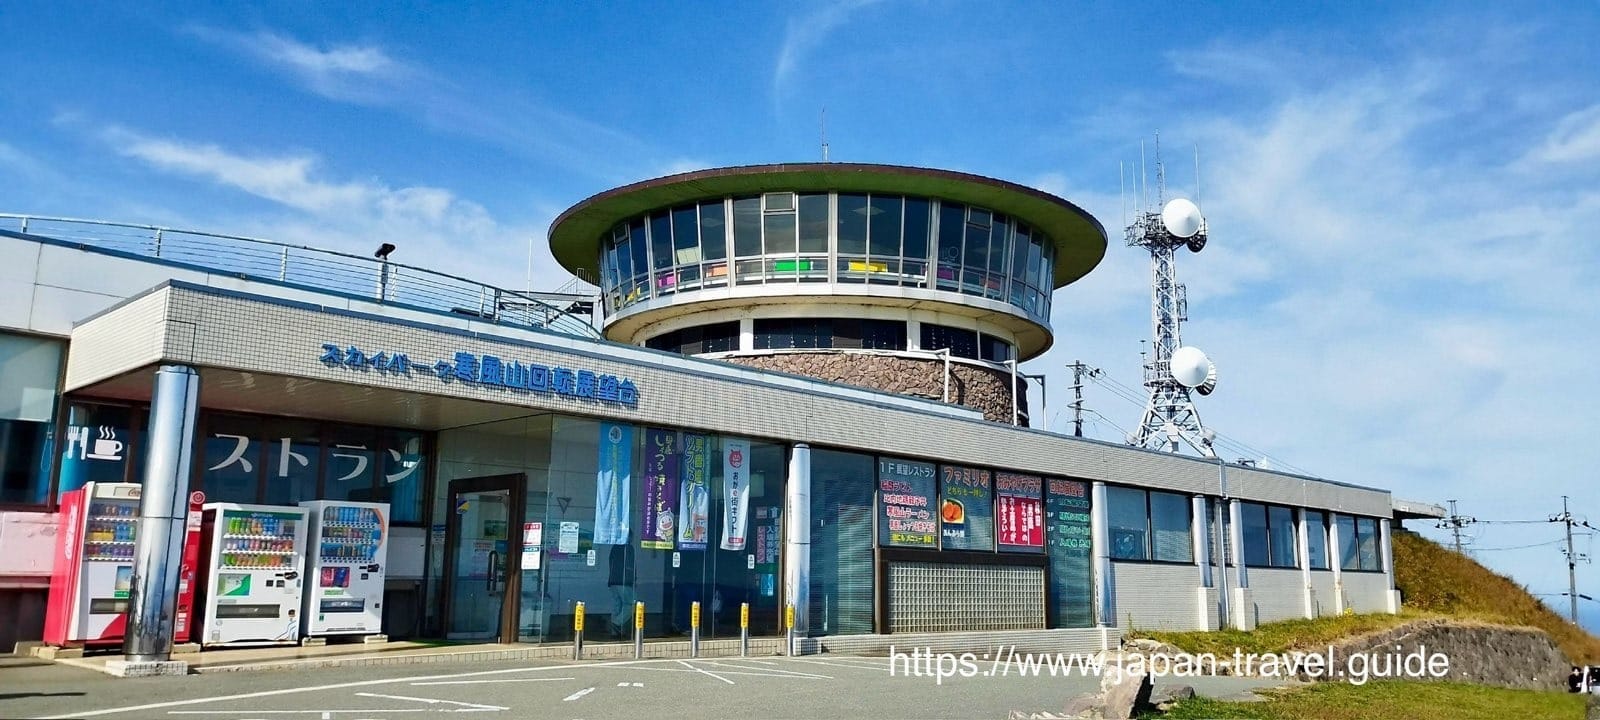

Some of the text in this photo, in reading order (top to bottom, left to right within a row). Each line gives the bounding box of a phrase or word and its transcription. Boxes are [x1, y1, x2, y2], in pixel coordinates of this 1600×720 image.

[209, 432, 423, 483] ストラン
[944, 466, 990, 489] ファミリオ
